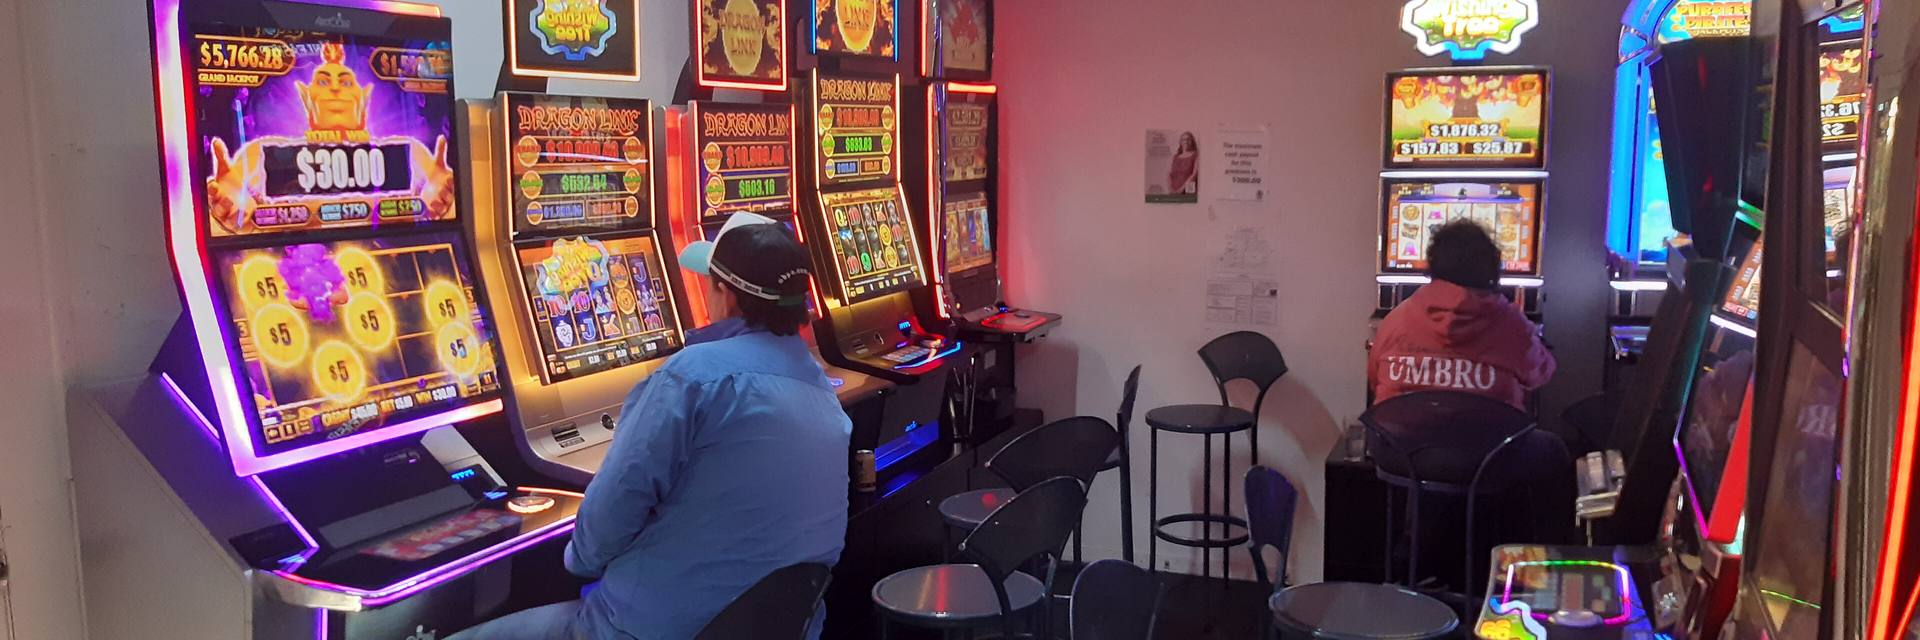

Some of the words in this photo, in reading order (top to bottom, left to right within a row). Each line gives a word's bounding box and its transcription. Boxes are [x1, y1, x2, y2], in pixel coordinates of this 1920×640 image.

[200, 41, 283, 69] $5,766.28
[198, 73, 226, 83] GRAND
[227, 74, 259, 83] JACKPOT
[820, 79, 867, 101] DRAGON
[517, 105, 597, 131] DRAGON
[600, 109, 641, 135] LINK
[704, 112, 768, 137] DRAGON
[768, 114, 790, 136] LIN
[306, 130, 342, 142] TOTAL
[345, 130, 370, 142] WIN
[296, 147, 386, 193] $30.00
[342, 203, 367, 220] $750
[256, 276, 278, 298] $5
[348, 267, 367, 287] $5
[439, 298, 457, 318] $5
[360, 310, 380, 332] $5
[270, 322, 292, 346] $5
[450, 338, 467, 358] $5
[328, 360, 350, 383] $5
[1387, 356, 1496, 390] UMBRO
[415, 392, 432, 404] WIN
